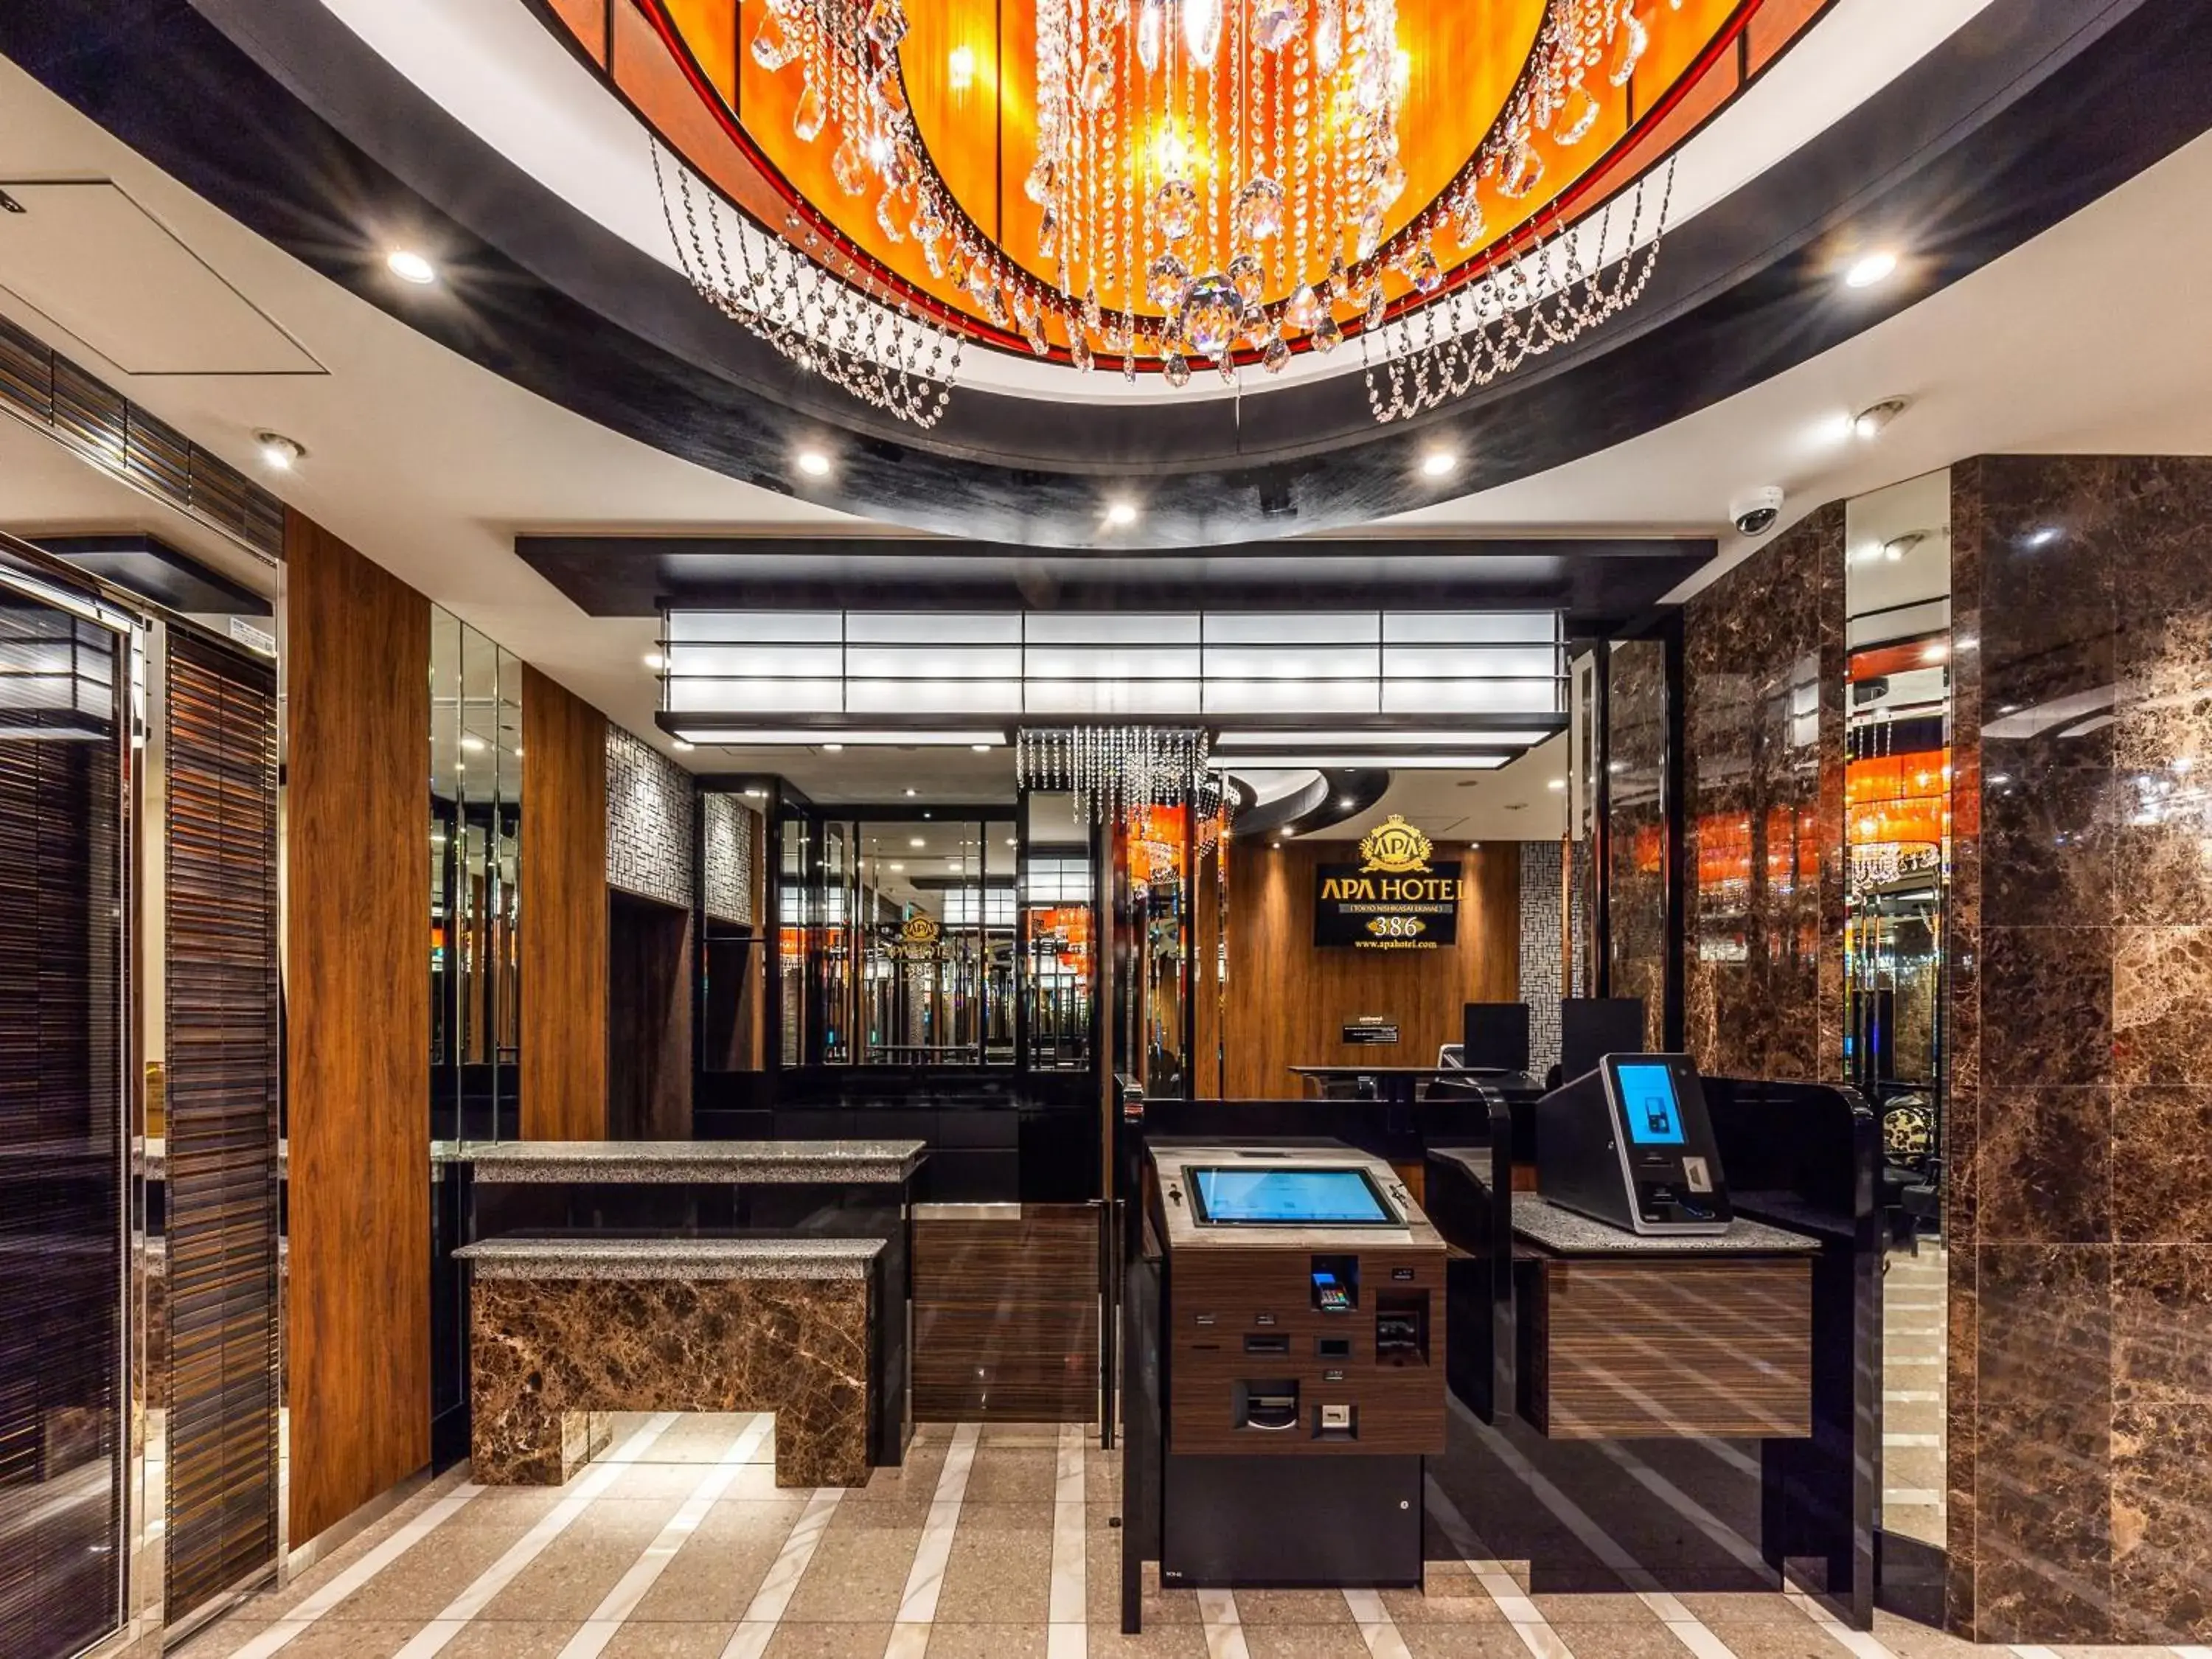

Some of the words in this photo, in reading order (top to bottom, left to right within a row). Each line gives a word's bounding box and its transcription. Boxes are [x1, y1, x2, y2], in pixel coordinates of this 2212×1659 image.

[1321, 878, 1375, 900] APA
[1374, 917, 1417, 936] 386
[1354, 939, 1437, 950] www.apahotel.com
